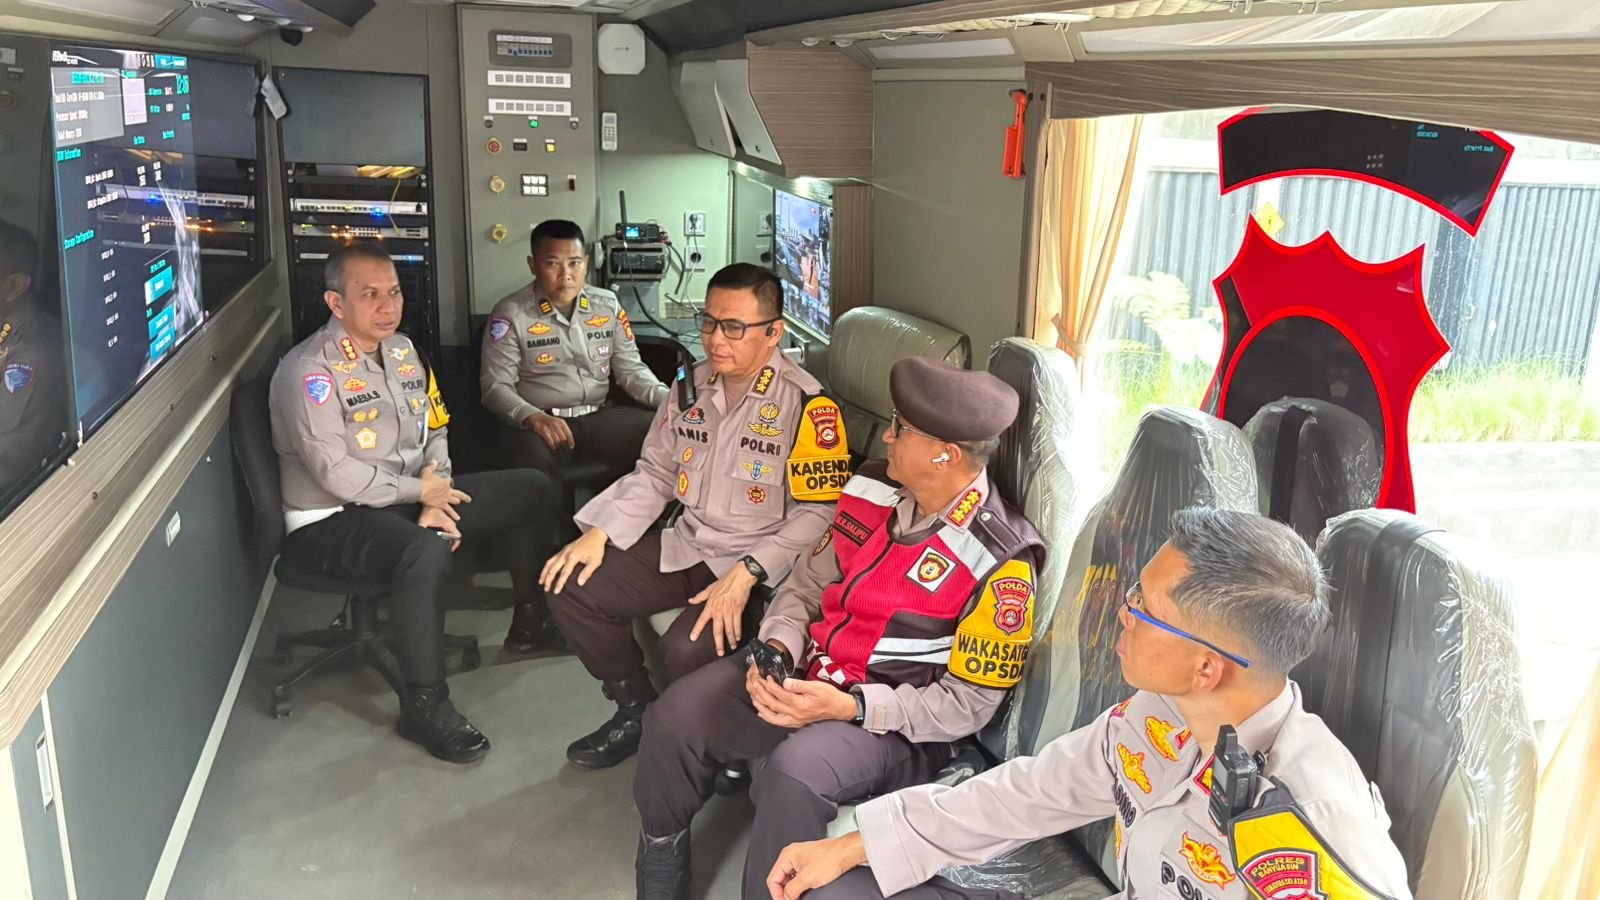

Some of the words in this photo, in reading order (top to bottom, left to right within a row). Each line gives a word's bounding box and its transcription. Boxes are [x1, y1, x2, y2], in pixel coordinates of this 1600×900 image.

[812, 407, 835, 416] POLDA
[678, 427, 708, 443] ANIS
[740, 436, 781, 456] POLRI
[999, 582, 1027, 593] POLDA
[1251, 857, 1305, 877] POLRES
[1258, 863, 1299, 878] BANYUASIN
